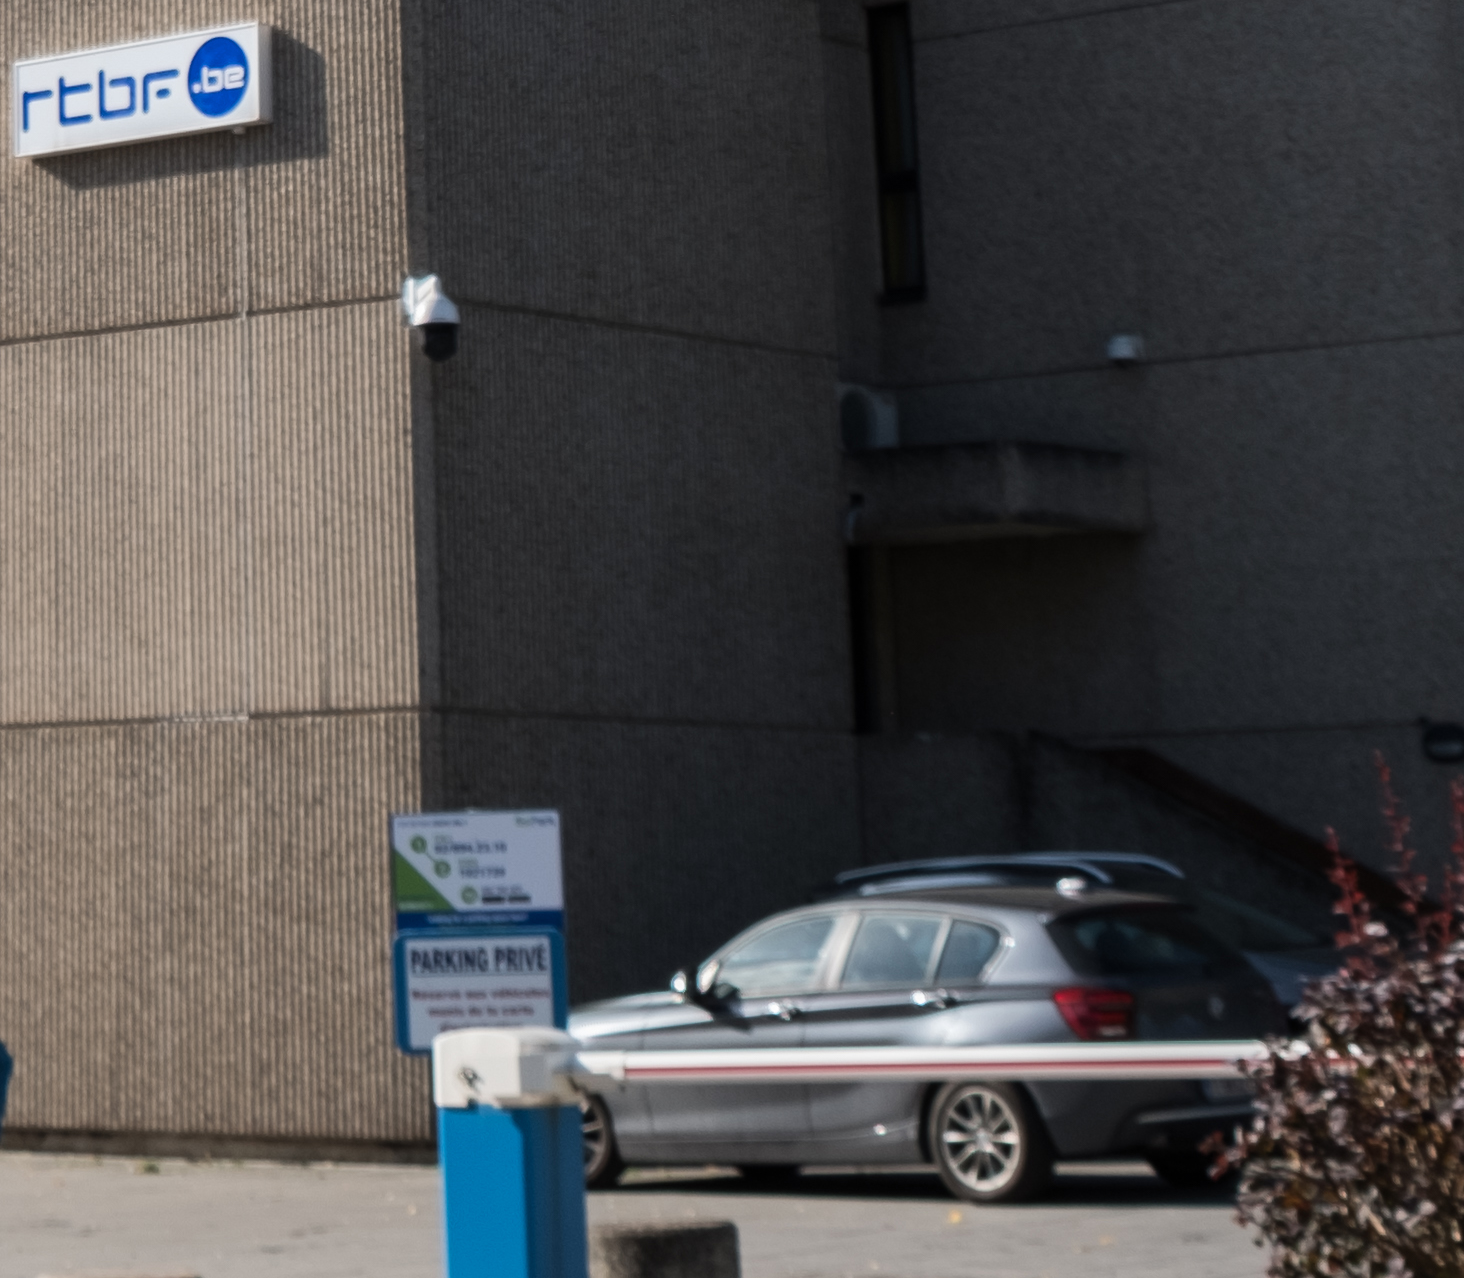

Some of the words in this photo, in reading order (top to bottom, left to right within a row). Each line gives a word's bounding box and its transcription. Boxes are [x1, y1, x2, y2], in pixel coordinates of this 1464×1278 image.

[191, 63, 246, 95] .be
[411, 948, 489, 974] PARKING
[494, 943, 547, 972] PRIVÉ
